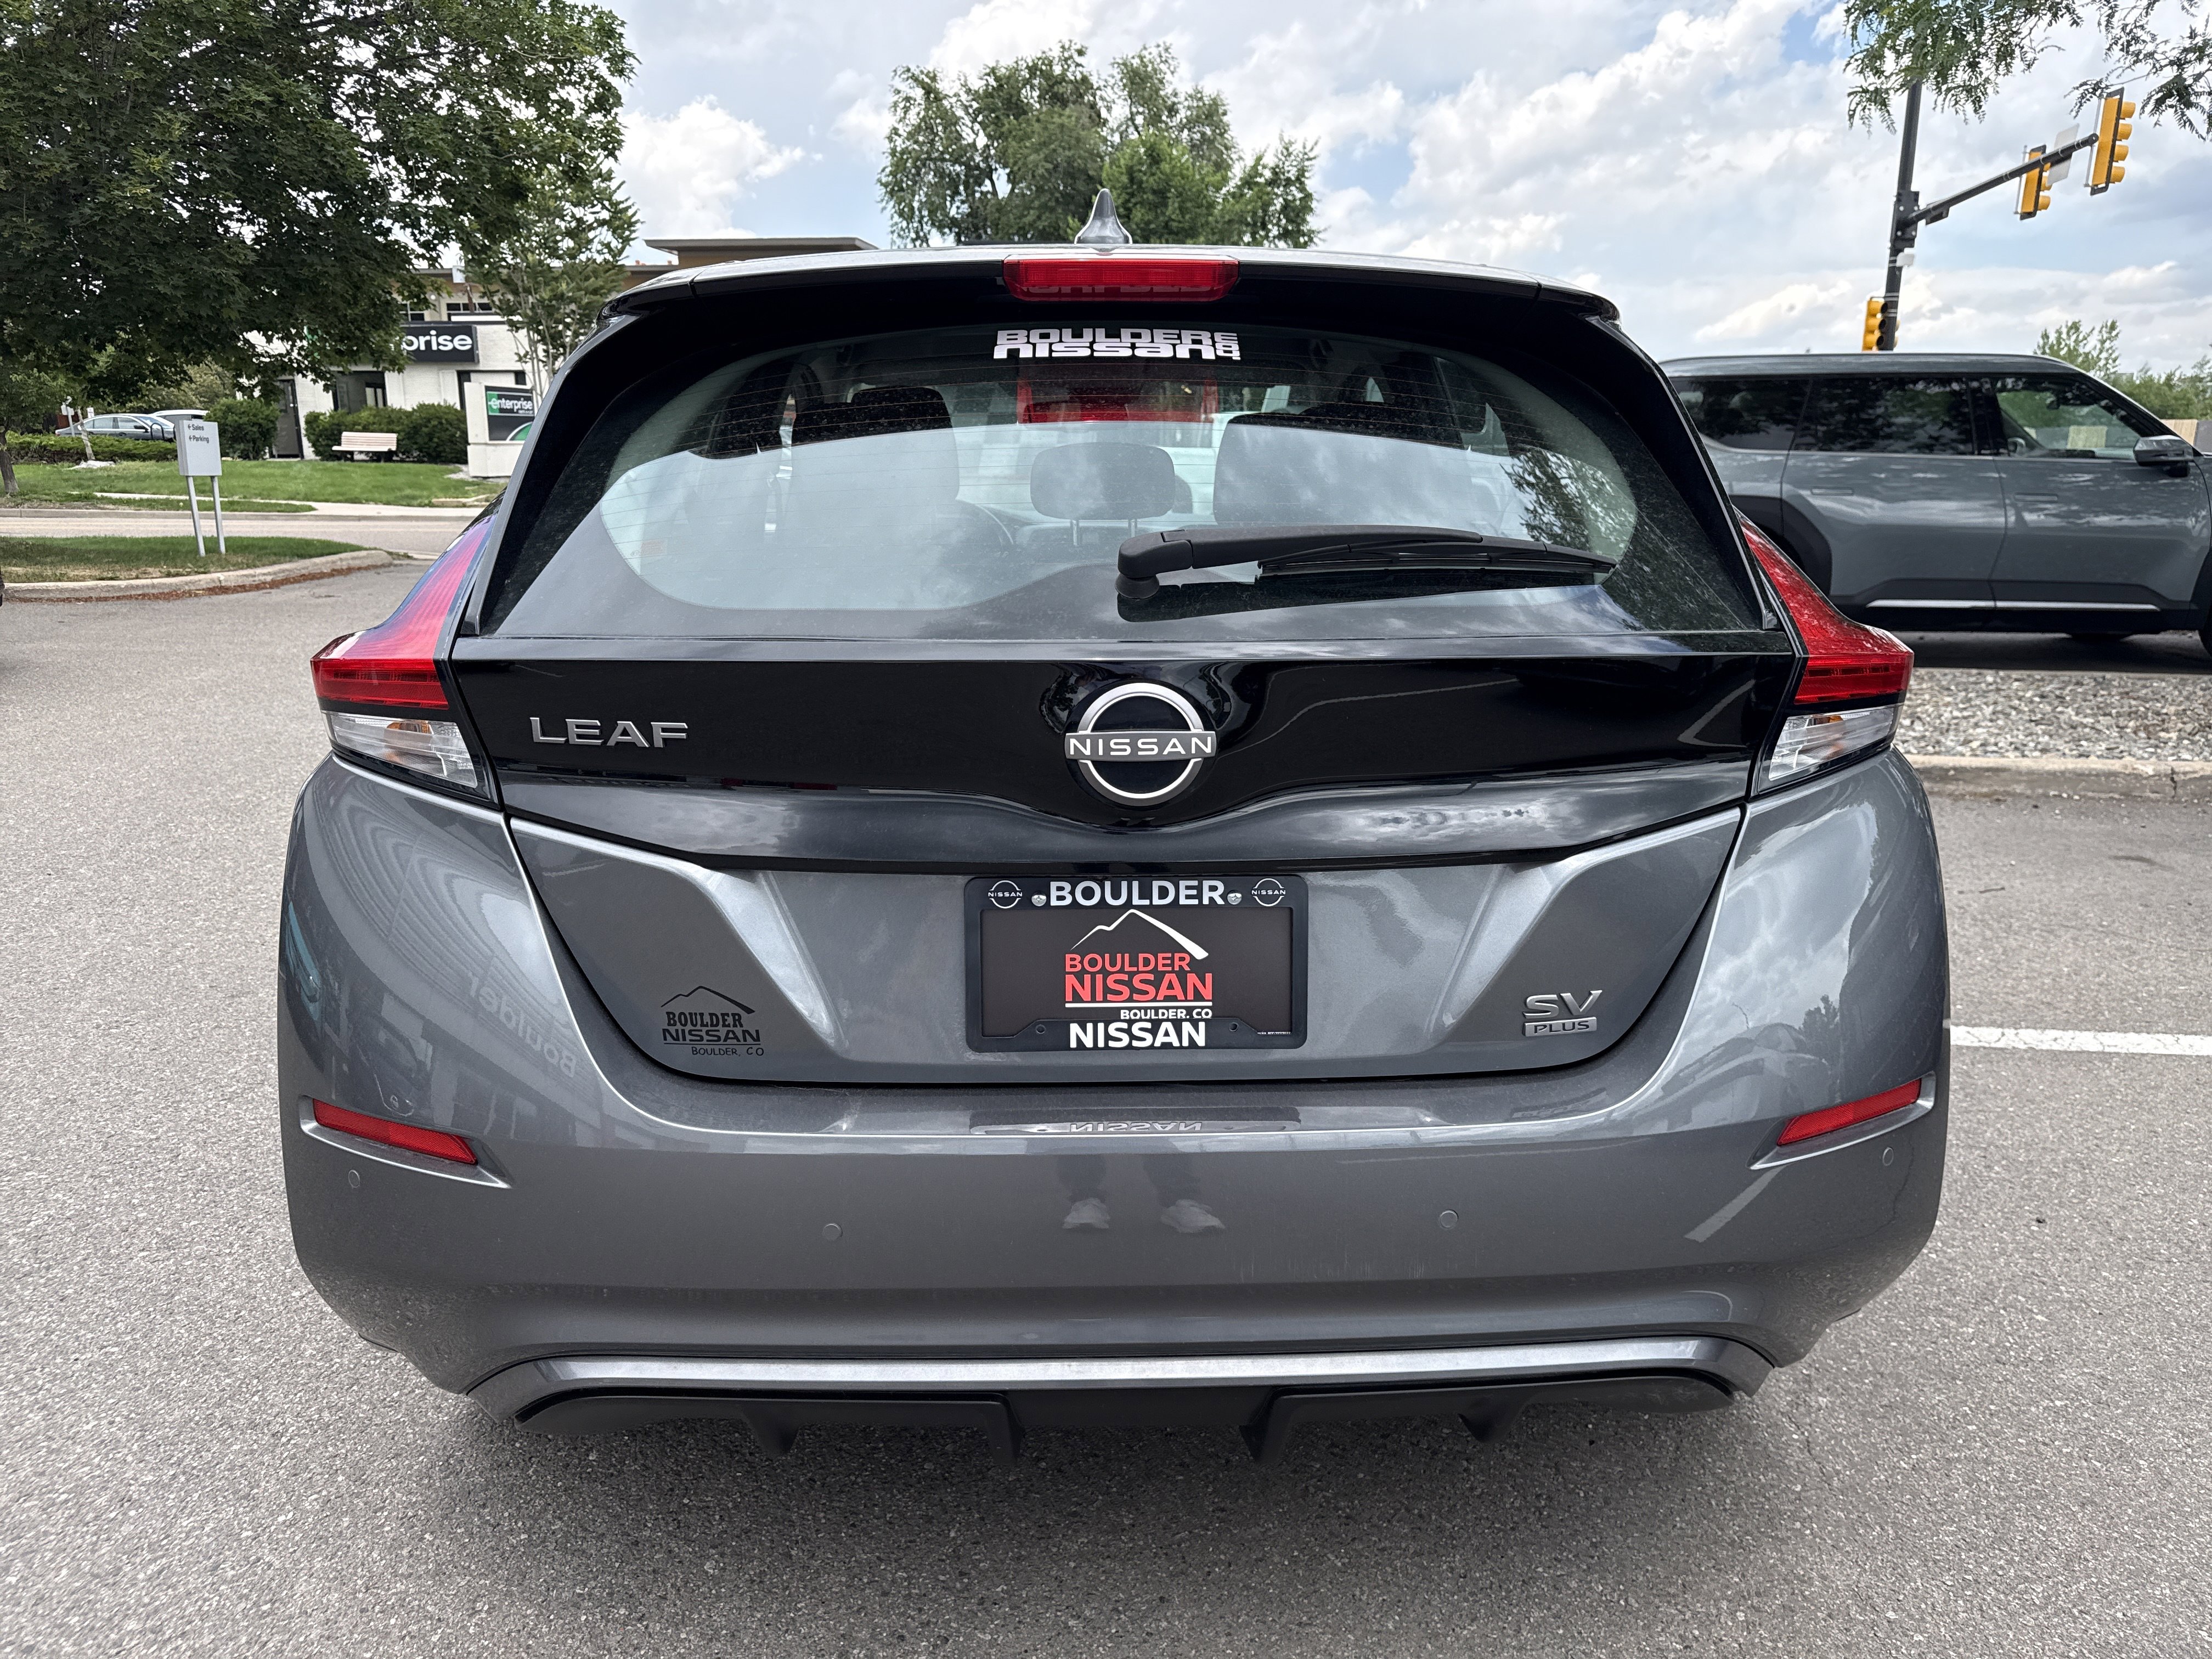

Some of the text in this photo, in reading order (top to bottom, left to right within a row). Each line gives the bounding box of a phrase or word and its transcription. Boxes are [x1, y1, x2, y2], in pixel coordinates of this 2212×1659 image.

[997, 328, 1212, 345] BOULDER
[488, 398, 533, 412] enterprise
[193, 435, 210, 443] Parking
[529, 717, 688, 748] LEAF
[1070, 736, 1211, 755] NISSAN
[1050, 880, 1225, 906] BOULDER
[1065, 953, 1190, 972] BOULDER
[1065, 973, 1212, 1002] NISSAN
[1522, 990, 1602, 1019] SV
[665, 1011, 743, 1028] BOULDER
[1192, 1008, 1212, 1019] CO
[662, 1028, 761, 1042] NISSAN
[1070, 1022, 1205, 1048] NISSAN
[1534, 1021, 1589, 1034] PLUS
[746, 1047, 764, 1056] CO
